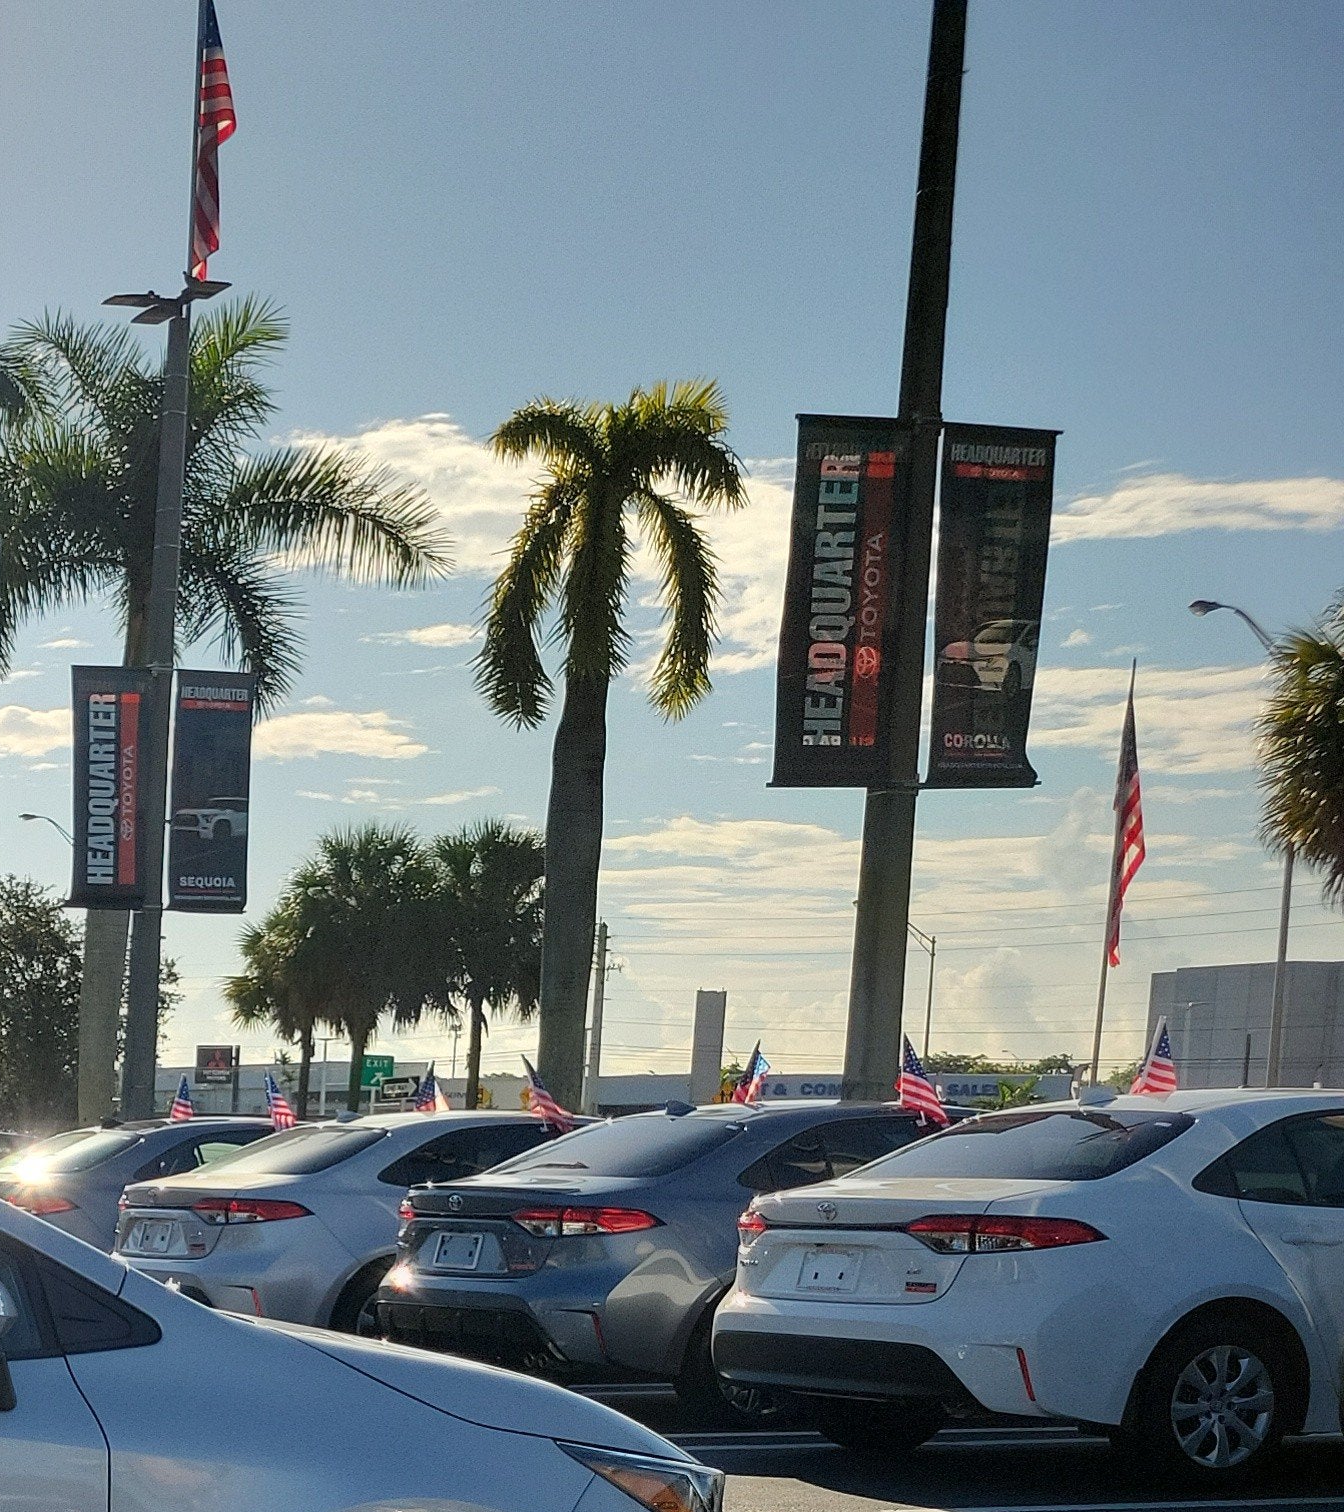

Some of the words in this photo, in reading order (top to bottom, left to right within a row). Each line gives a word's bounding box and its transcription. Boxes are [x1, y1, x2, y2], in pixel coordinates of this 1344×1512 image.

[802, 455, 860, 746] HEADQUARTER
[862, 532, 883, 646] TOYOTA
[87, 694, 116, 885] HEADQUARTER
[123, 745, 134, 815] TOYOTA
[179, 876, 237, 888] SEQUOIA
[366, 1058, 389, 1068] EXIT
